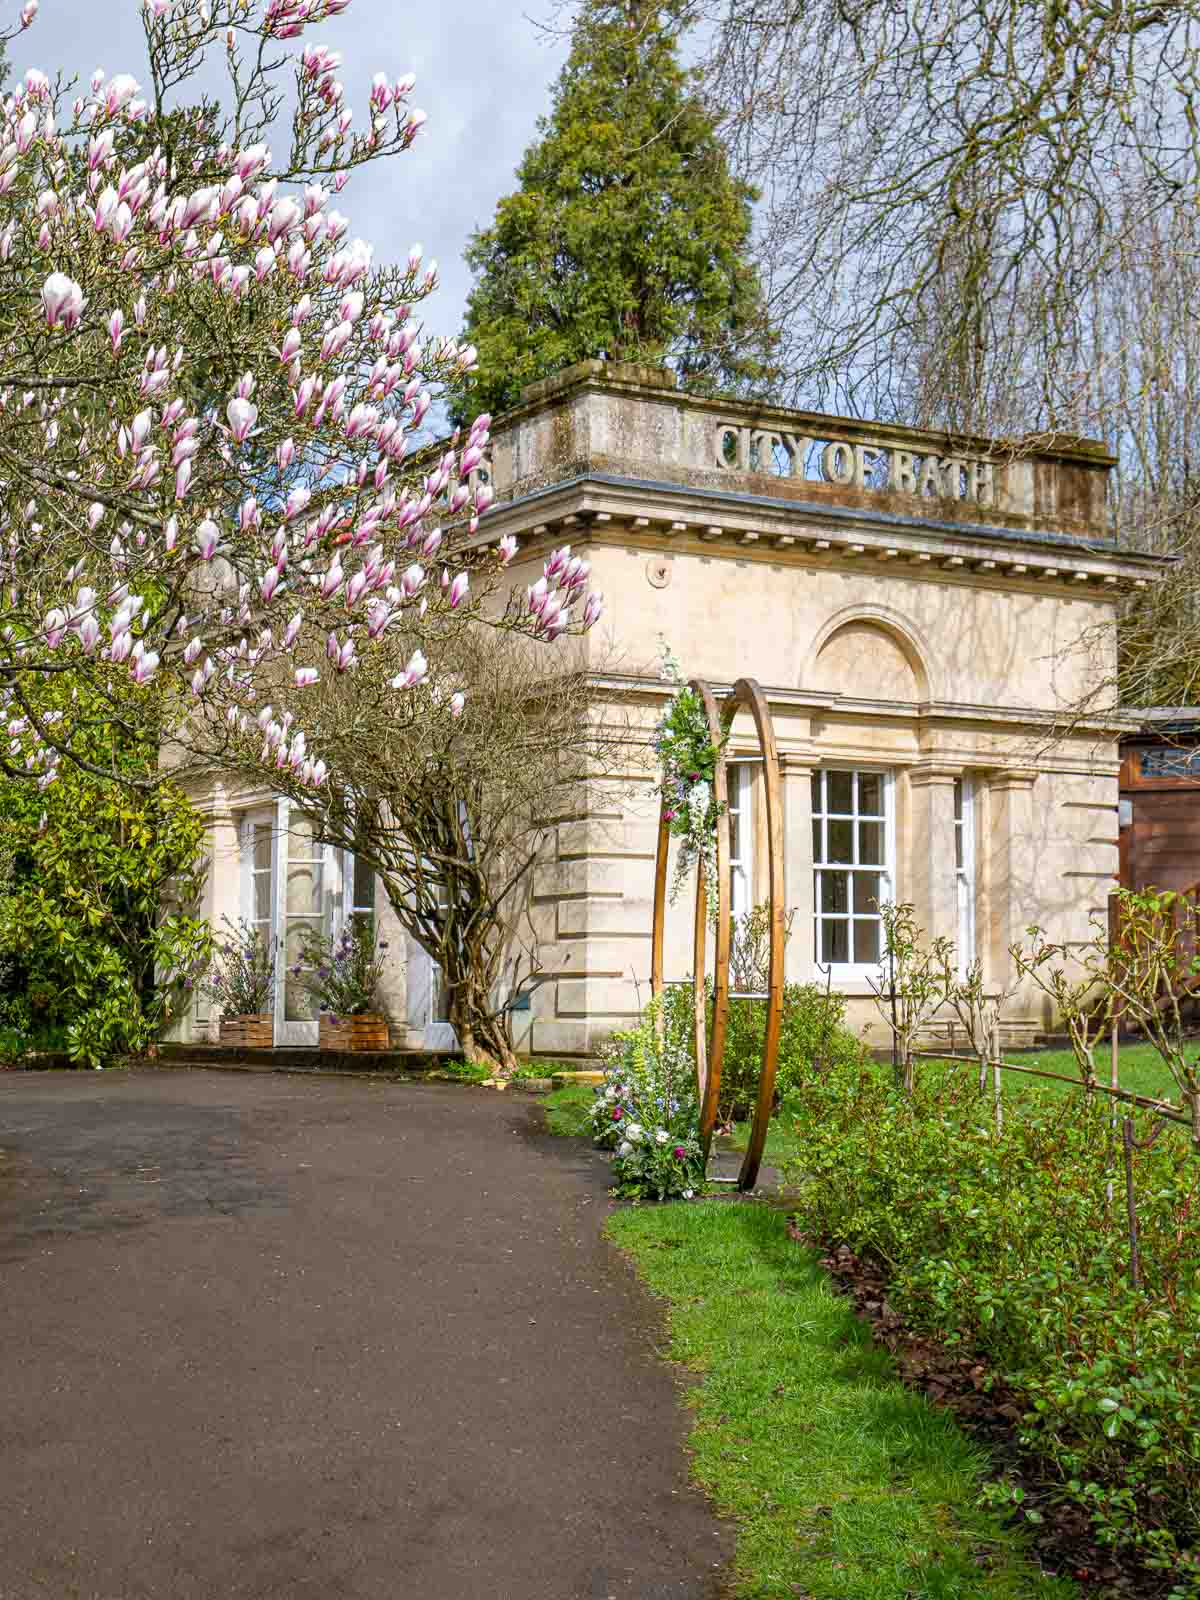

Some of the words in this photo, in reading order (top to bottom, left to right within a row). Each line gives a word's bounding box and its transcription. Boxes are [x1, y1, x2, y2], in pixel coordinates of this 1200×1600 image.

[716, 425, 811, 480] CITY
[822, 440, 881, 486] OF
[889, 449, 994, 504] BATH
